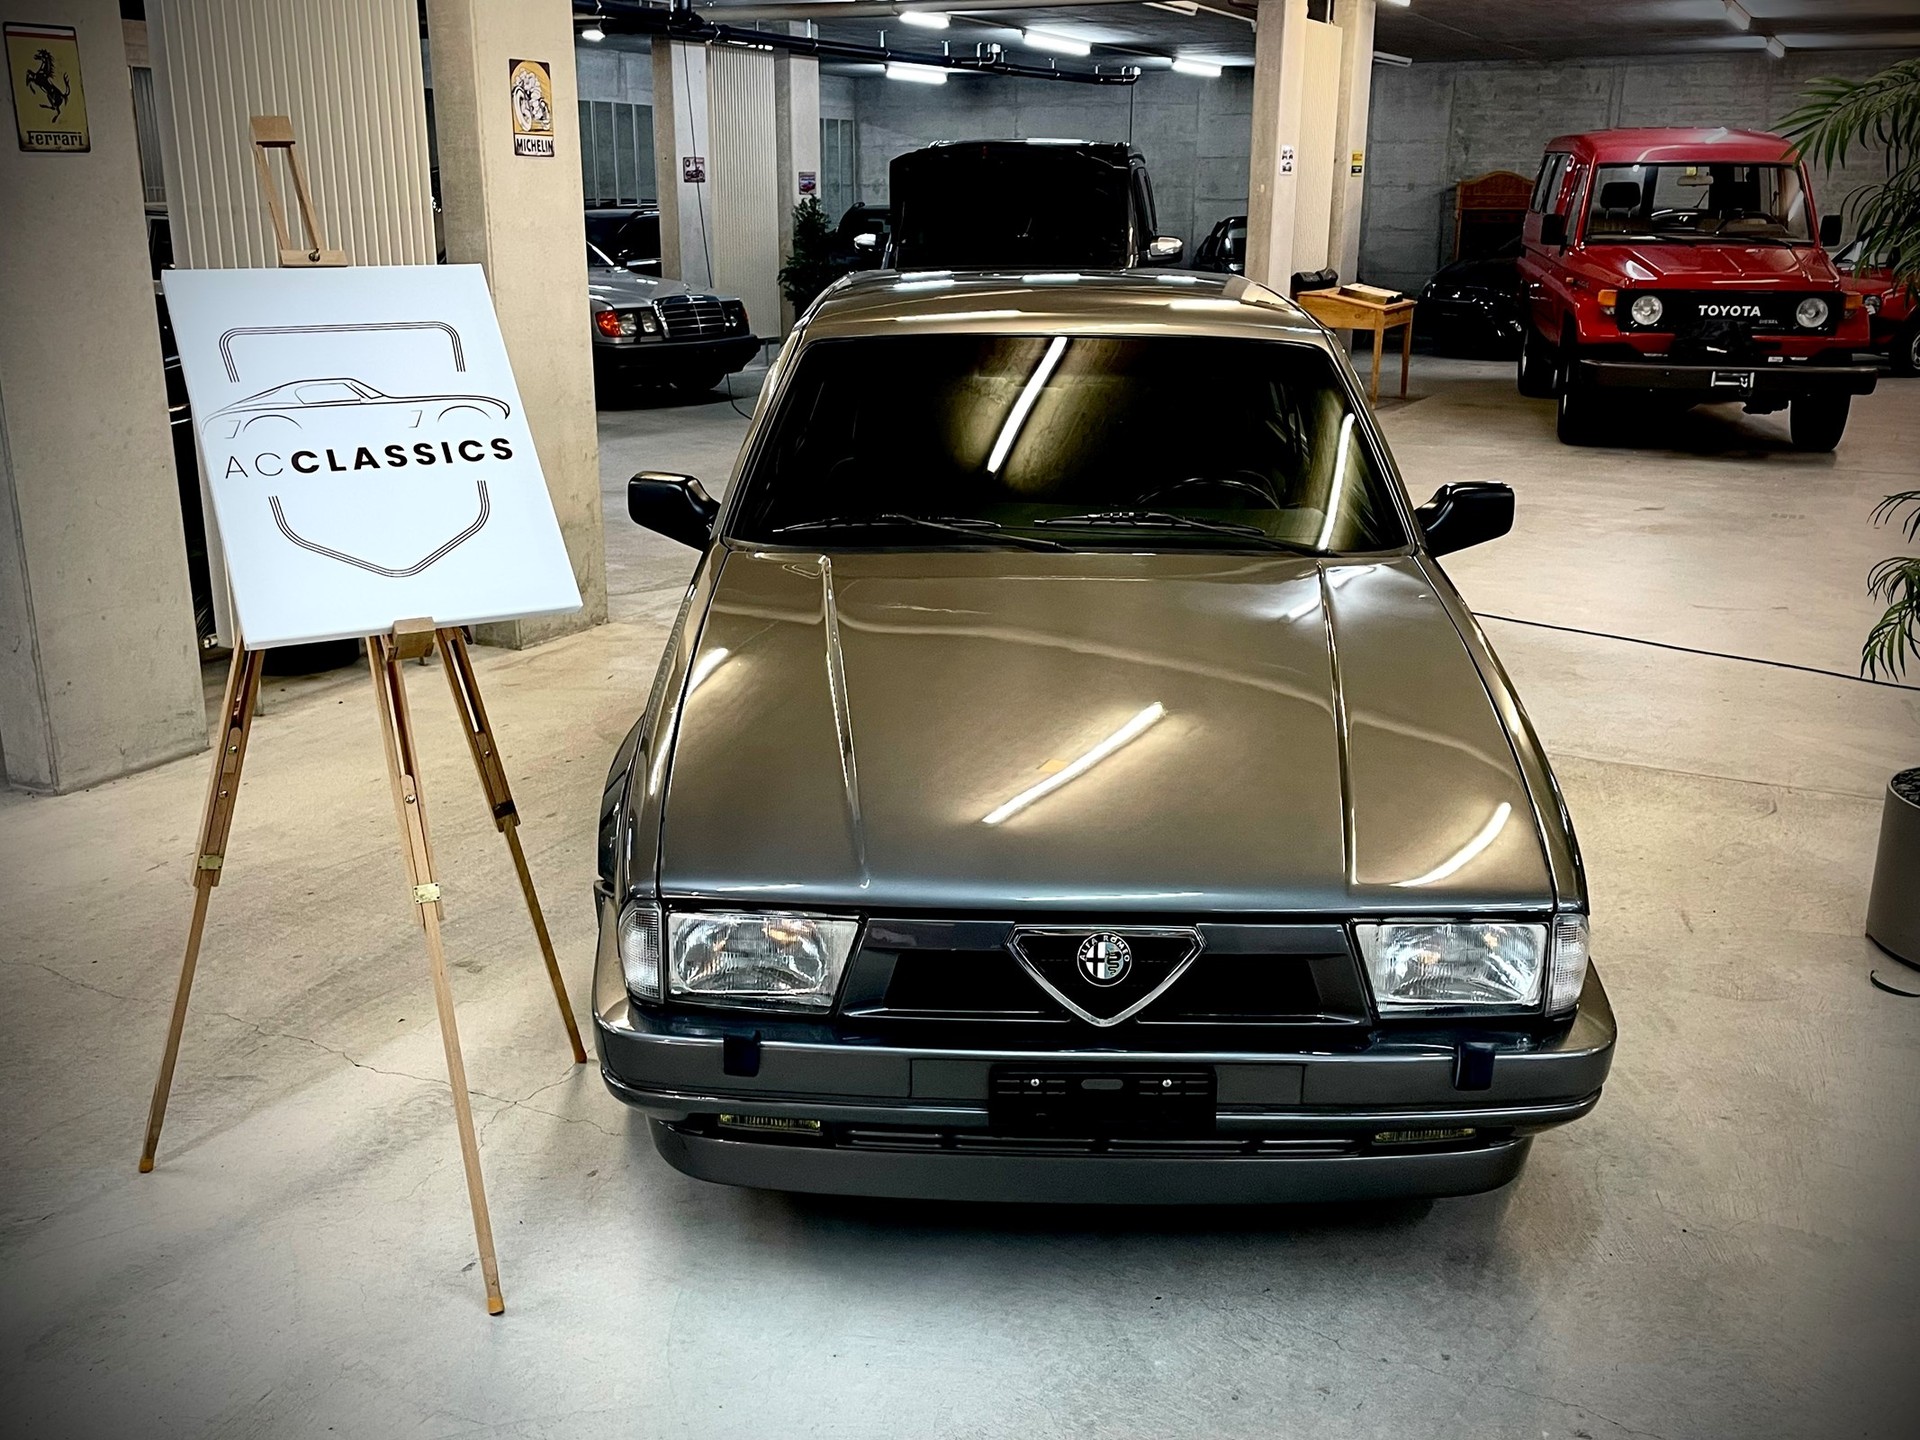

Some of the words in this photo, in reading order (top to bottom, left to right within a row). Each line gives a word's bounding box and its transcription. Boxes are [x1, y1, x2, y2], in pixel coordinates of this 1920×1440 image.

[26, 131, 84, 146] Ferrari
[516, 138, 553, 153] MICHELIN
[1698, 305, 1761, 317] TOYOTA
[1079, 937, 1098, 962] ALFA
[1103, 935, 1130, 962] ROMEO
